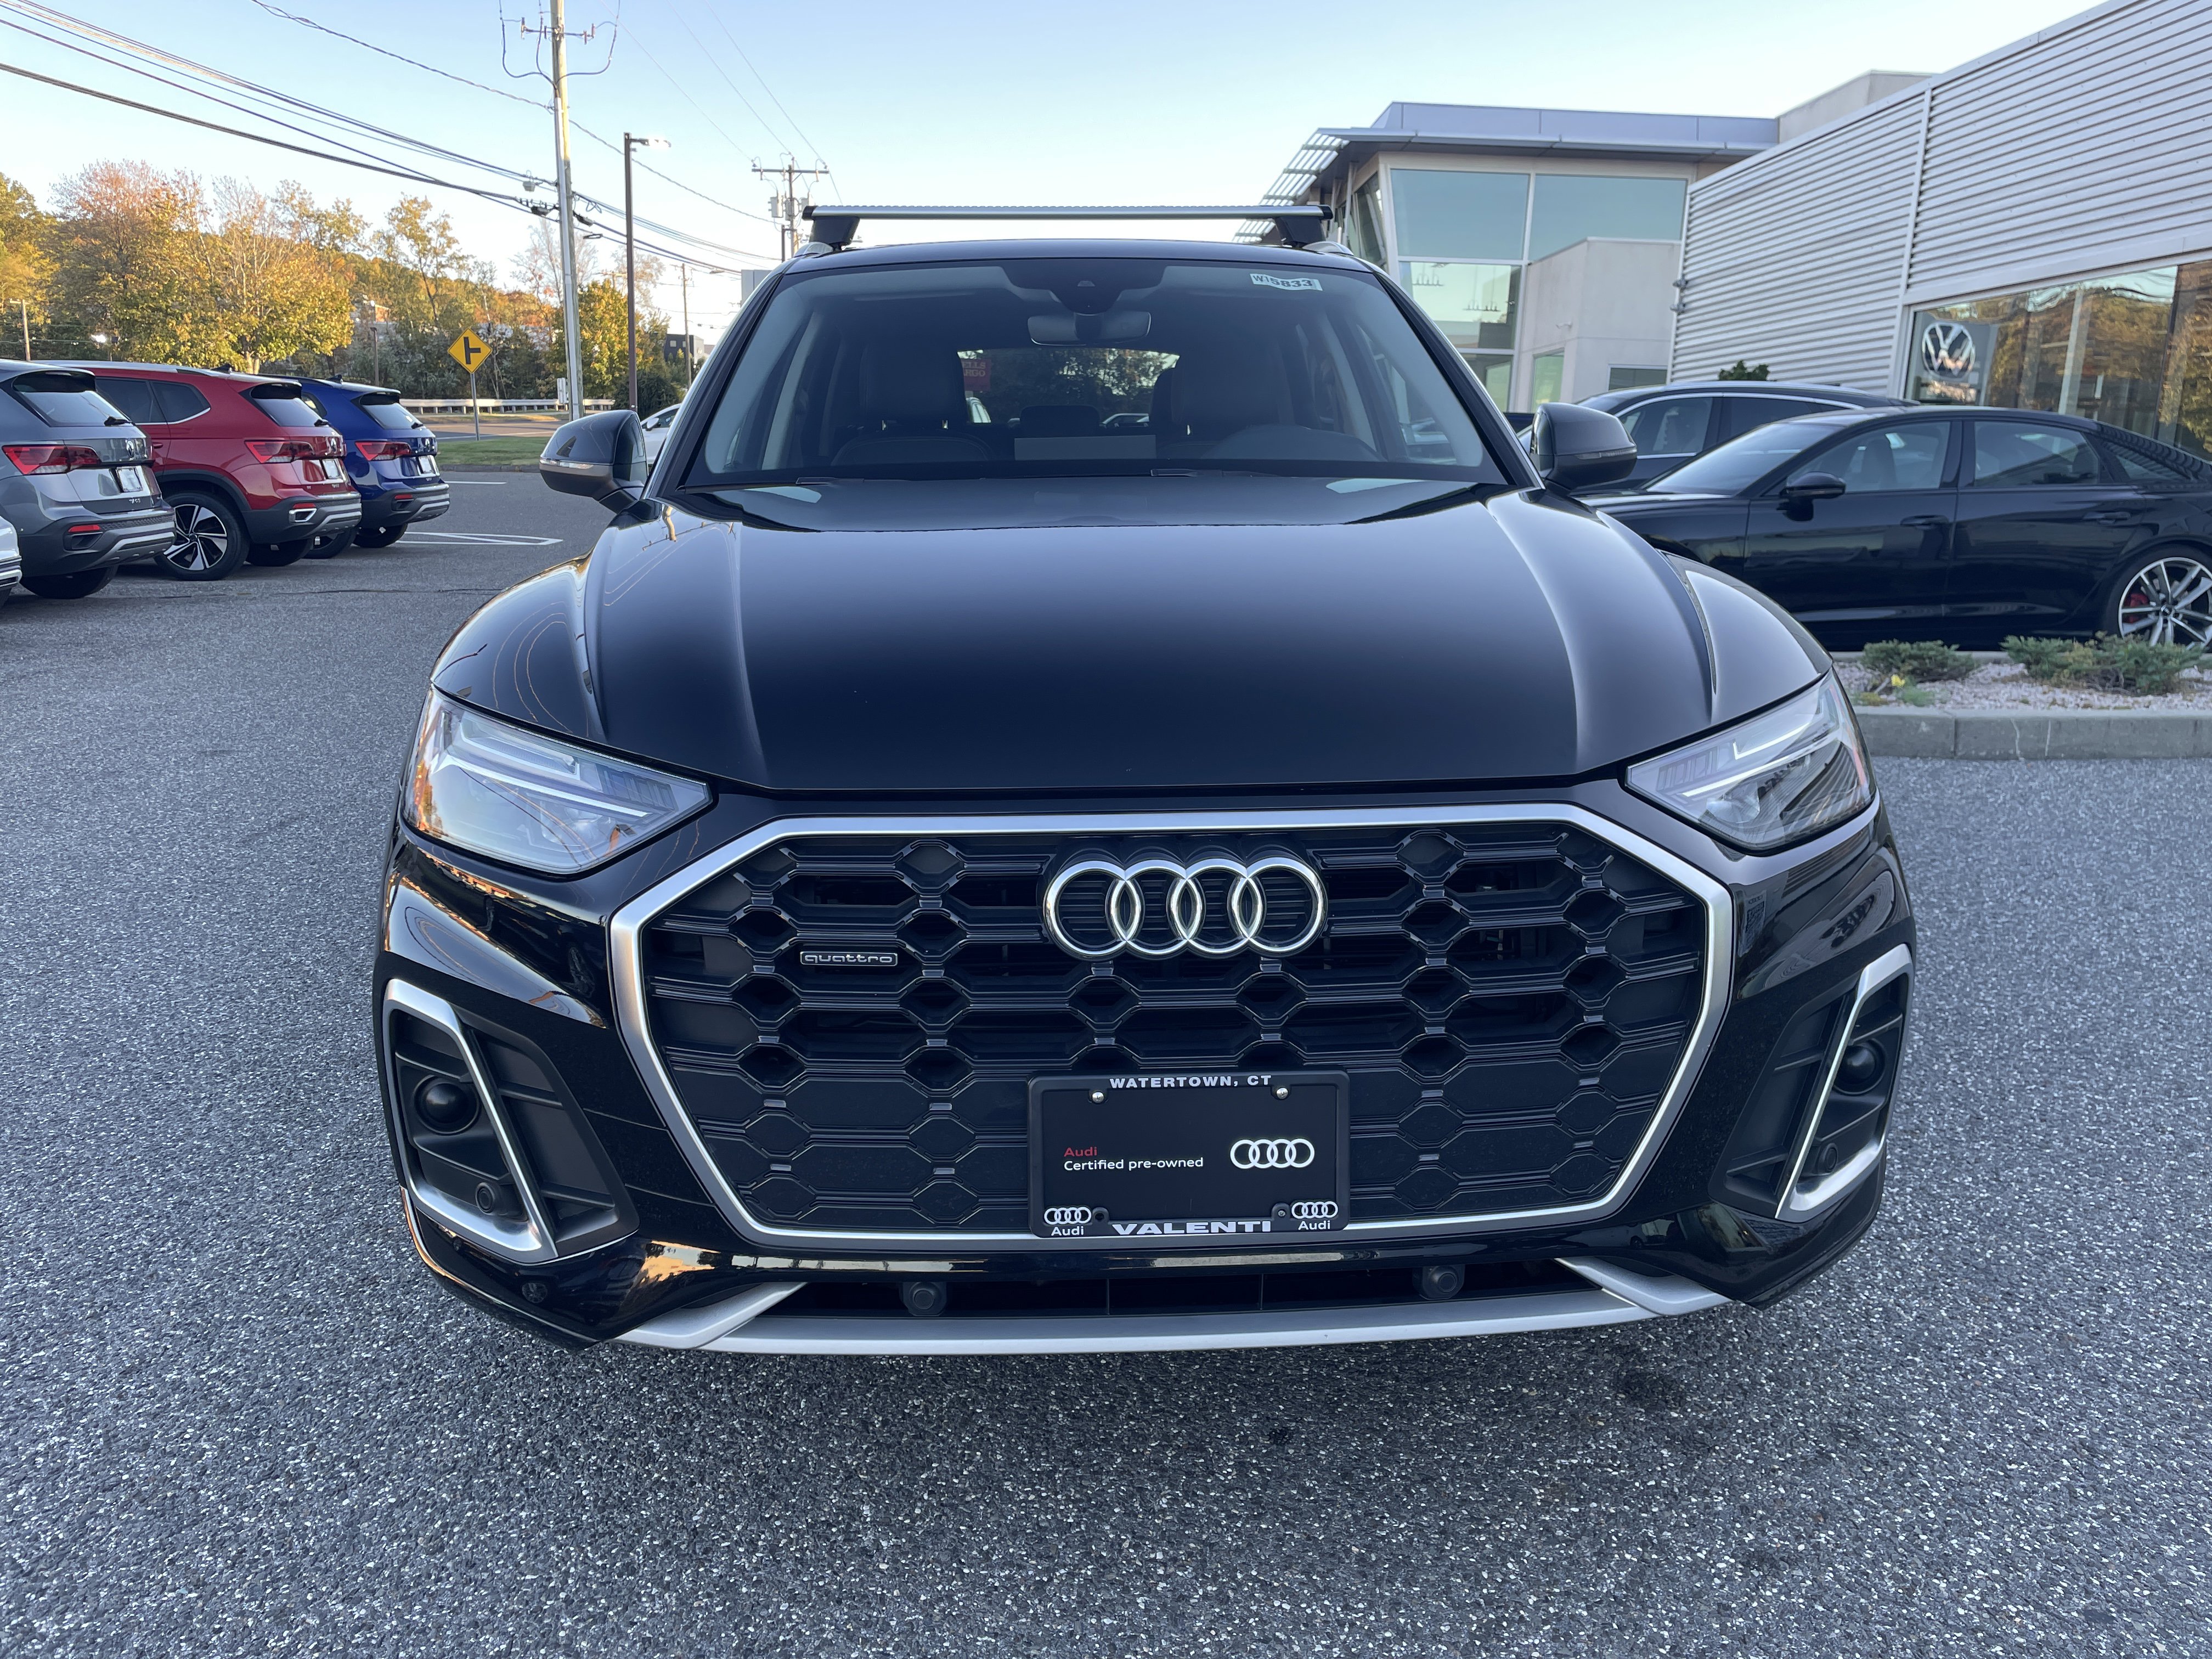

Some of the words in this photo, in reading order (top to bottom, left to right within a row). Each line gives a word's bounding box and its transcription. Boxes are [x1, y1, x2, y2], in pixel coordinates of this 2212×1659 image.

[1252, 275, 1313, 287] W15833
[804, 954, 893, 963] quattro
[1109, 1076, 1239, 1088] WATERTOWN,
[1247, 1075, 1272, 1086] CT
[1064, 1146, 1098, 1156] Audi
[1064, 1159, 1124, 1171] Certified
[1128, 1156, 1203, 1171] pre-owned
[1051, 1226, 1085, 1236] Audi
[1111, 1221, 1271, 1235] VALENTI
[1297, 1220, 1331, 1231] Audi
